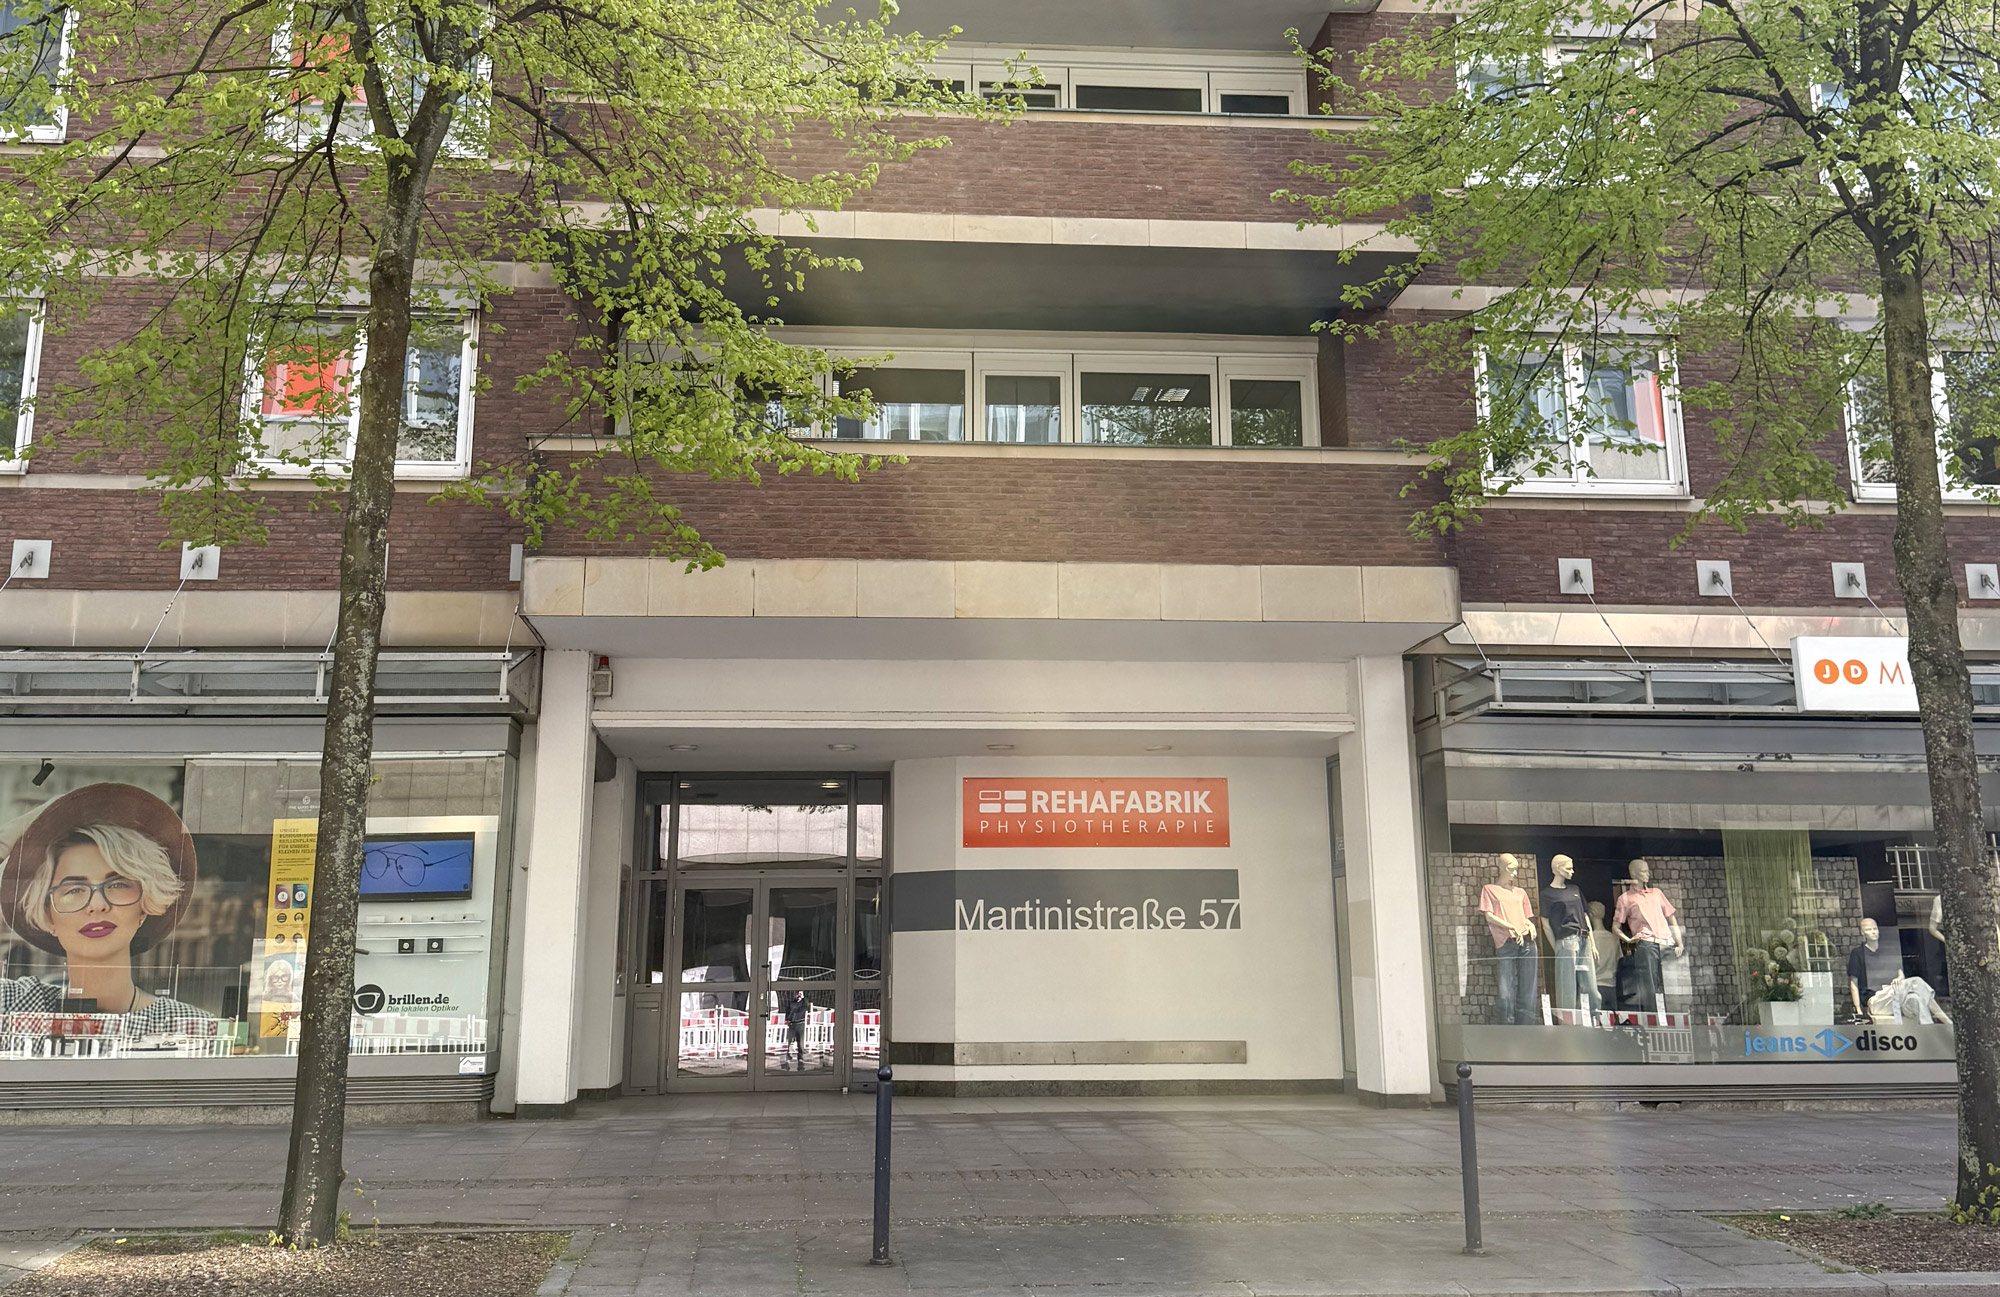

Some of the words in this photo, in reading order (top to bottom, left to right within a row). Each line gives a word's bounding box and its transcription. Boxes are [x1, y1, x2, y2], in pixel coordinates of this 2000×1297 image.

[1880, 661, 1914, 685] M
[1032, 790, 1212, 814] REHAFABRIK
[979, 818, 1217, 835] PHYSIOTHERAPIE
[954, 898, 1187, 931] Martinistraße
[1199, 899, 1241, 931] 57
[386, 1005, 400, 1013] Die
[401, 1005, 429, 1013] lokalen
[431, 1004, 459, 1013] Optiker
[388, 993, 450, 1005] brillen.de
[1744, 1030, 1807, 1057] jeans
[1856, 1030, 1918, 1051] disco
